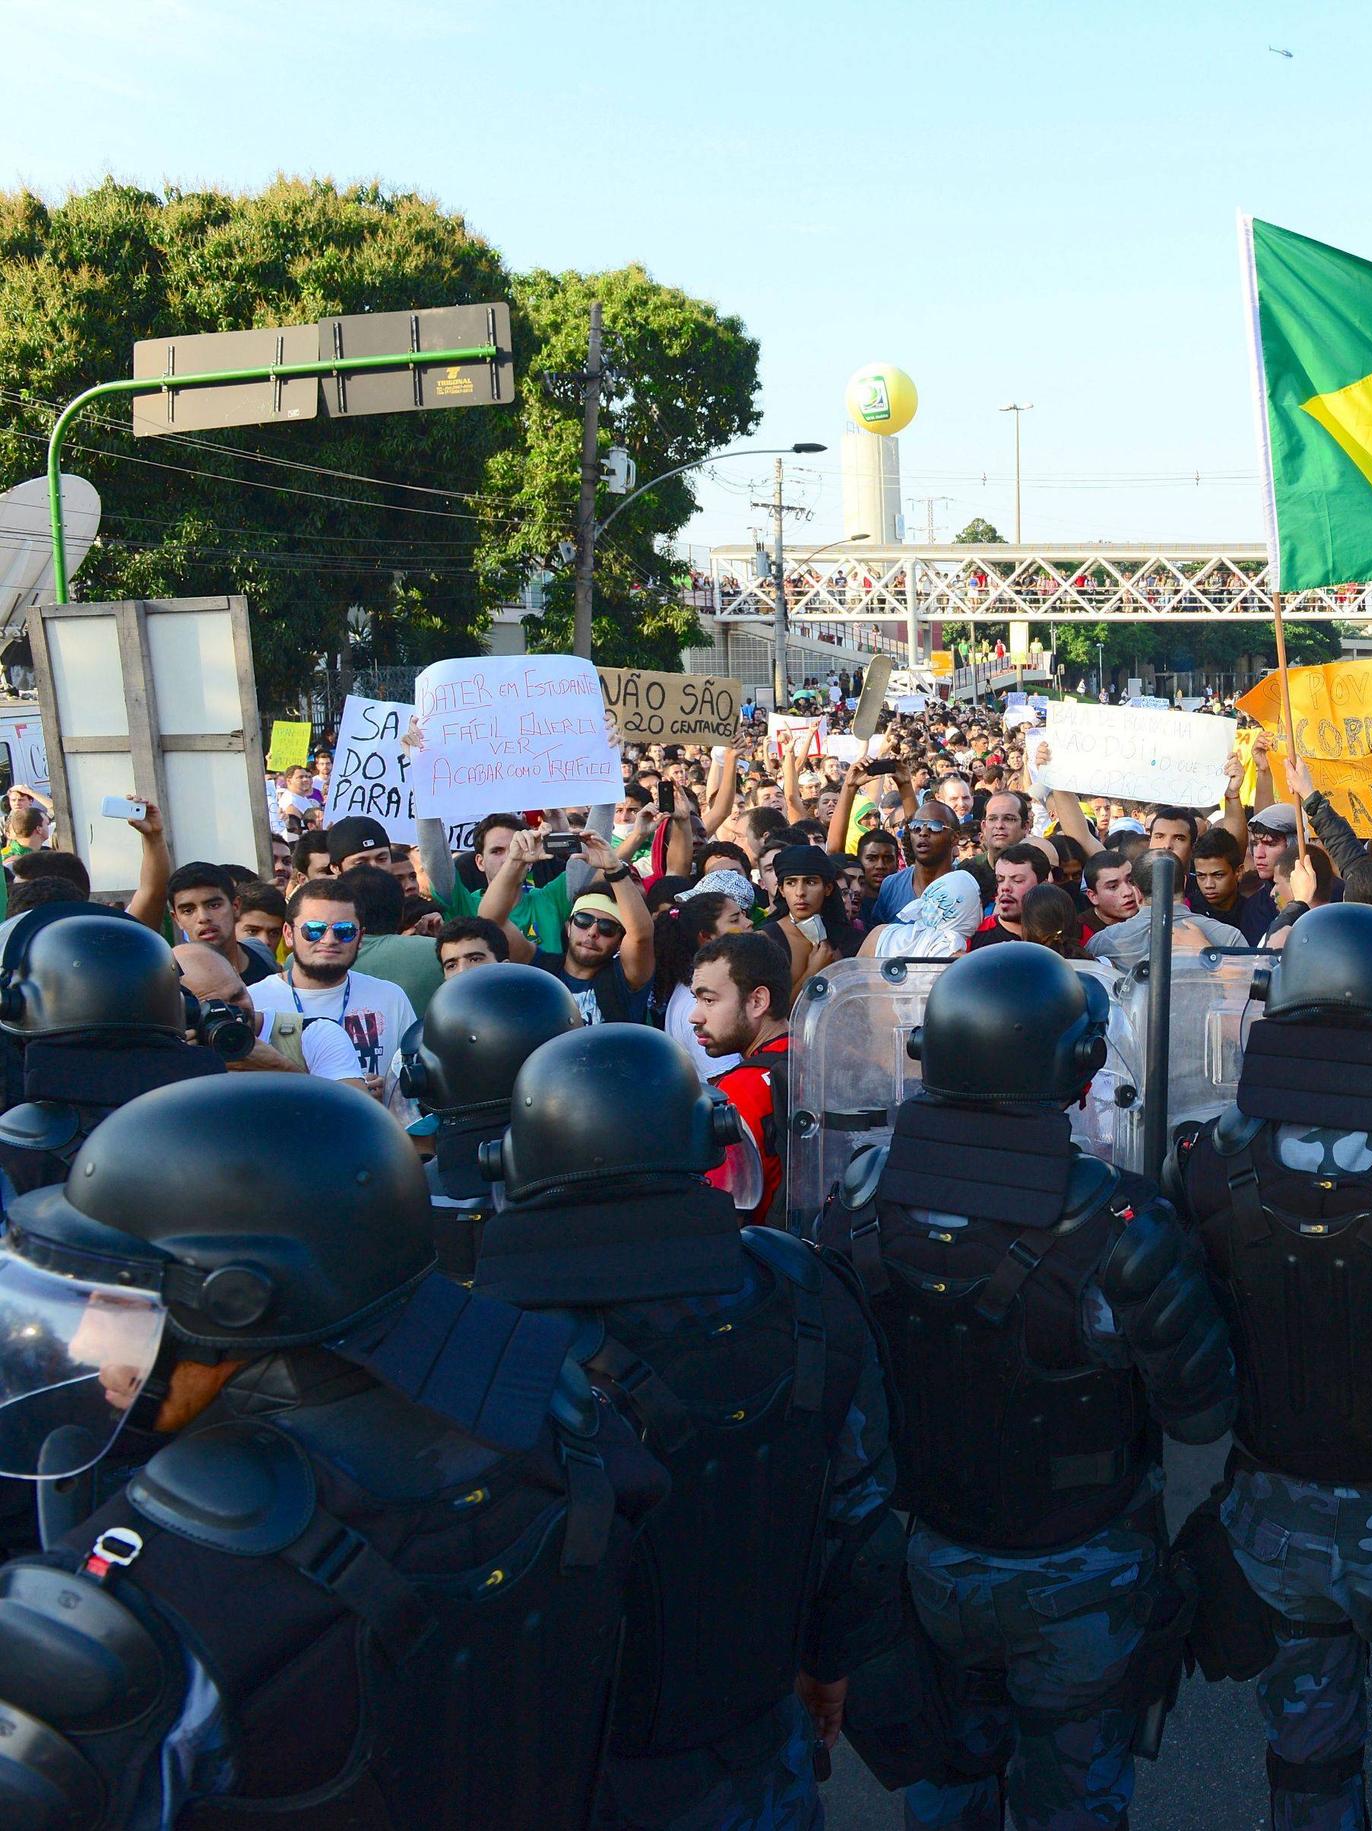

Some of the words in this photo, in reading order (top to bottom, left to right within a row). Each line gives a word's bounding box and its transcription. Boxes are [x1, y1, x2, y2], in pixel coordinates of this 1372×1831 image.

[421, 673, 493, 716] BATER
[525, 669, 600, 697] ESTUDANTE
[600, 672, 665, 711] NÃO
[680, 679, 733, 721] SÃO
[442, 713, 507, 744] FÁCIL
[624, 712, 664, 734] 20
[670, 716, 740, 737] CENTAVOS!
[489, 737, 537, 755] VER
[339, 748, 386, 780] DO
[432, 757, 504, 796] ACABAR
[333, 778, 401, 818] PARA
